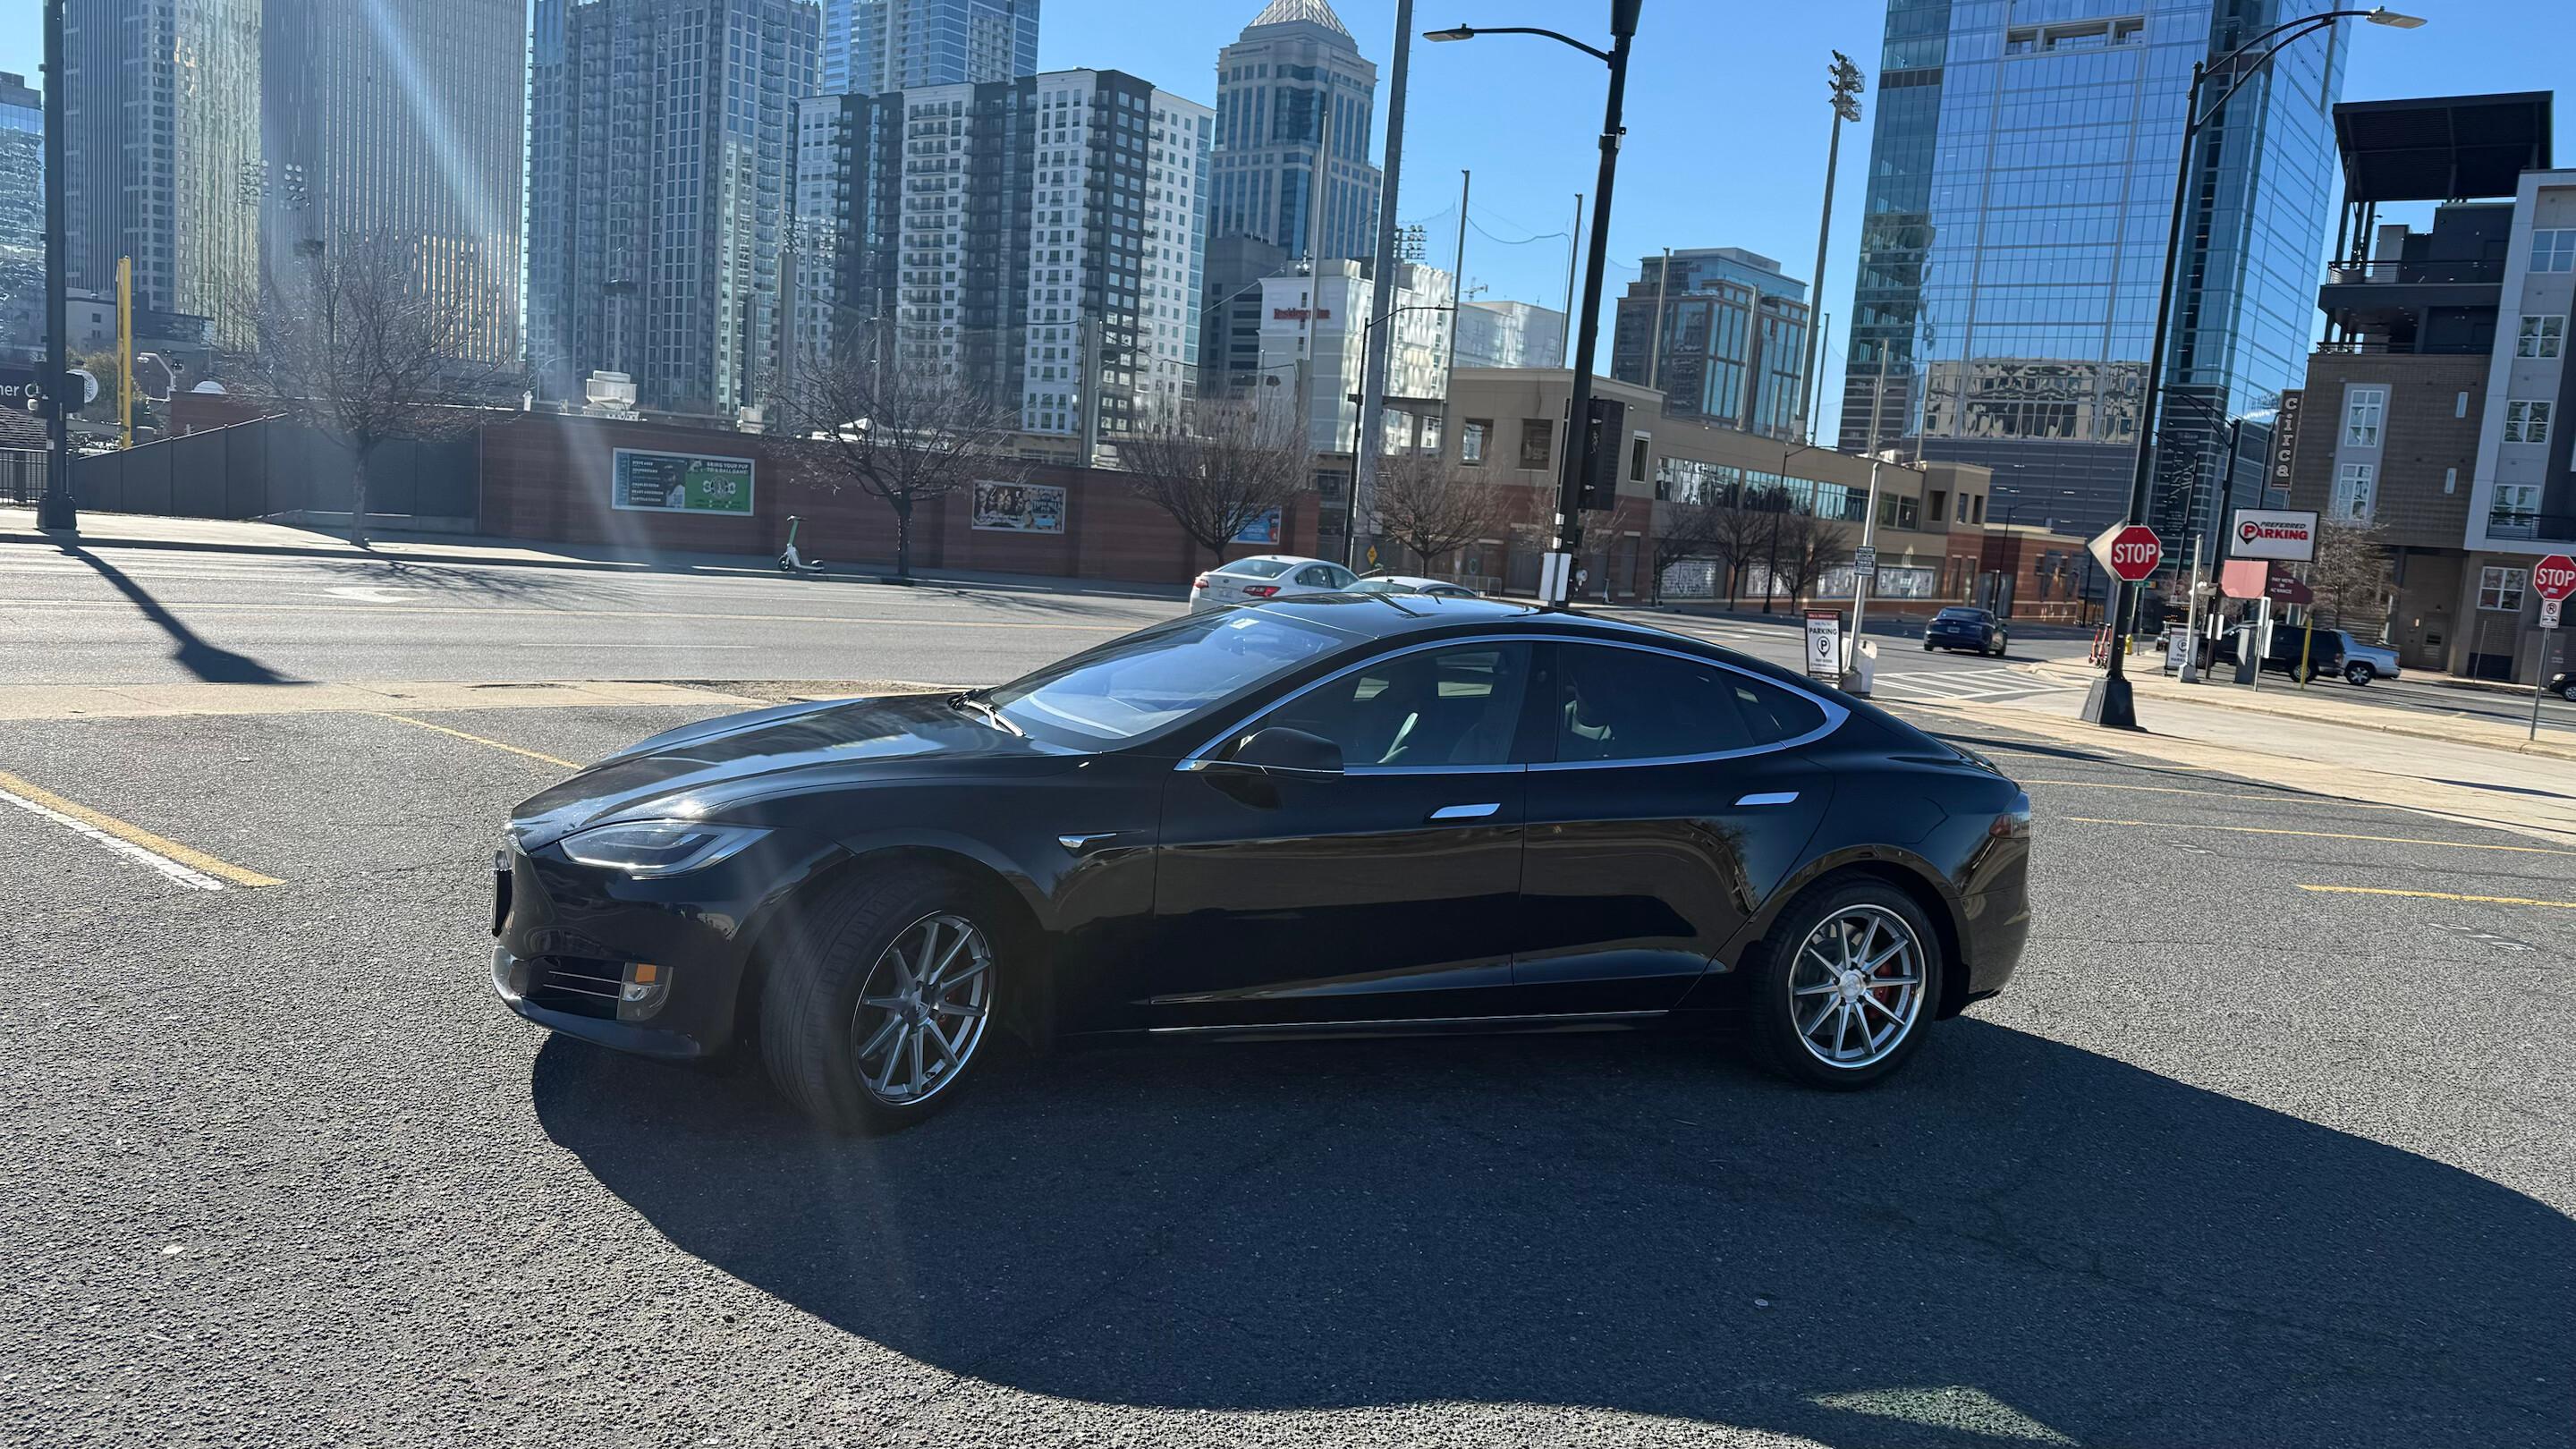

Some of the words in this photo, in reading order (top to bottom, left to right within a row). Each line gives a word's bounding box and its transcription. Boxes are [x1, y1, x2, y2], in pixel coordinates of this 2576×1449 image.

[2244, 525, 2309, 540] PARKING
[2260, 521, 2307, 530] PREFERRED
[2114, 543, 2157, 564] STOP
[2537, 568, 2576, 587] STOP
[1809, 627, 1838, 635] PARKING
